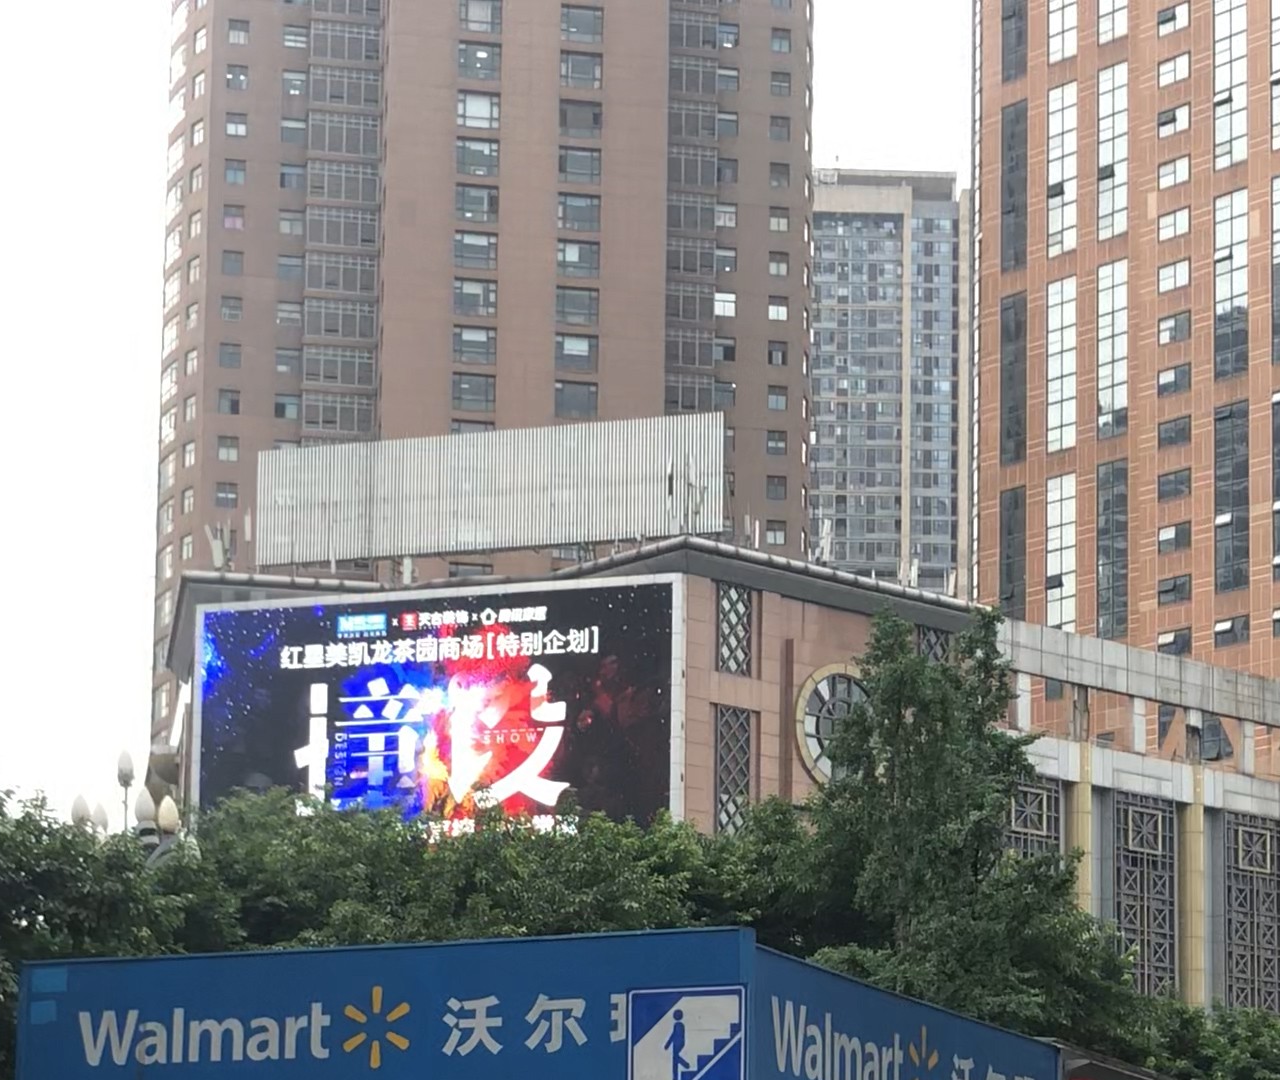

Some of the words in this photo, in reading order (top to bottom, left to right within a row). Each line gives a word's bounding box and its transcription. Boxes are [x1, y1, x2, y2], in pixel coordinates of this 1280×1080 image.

[482, 732, 538, 744] SHOW
[78, 1001, 331, 1067] Walmart
[441, 992, 627, 1056] 沃尔
